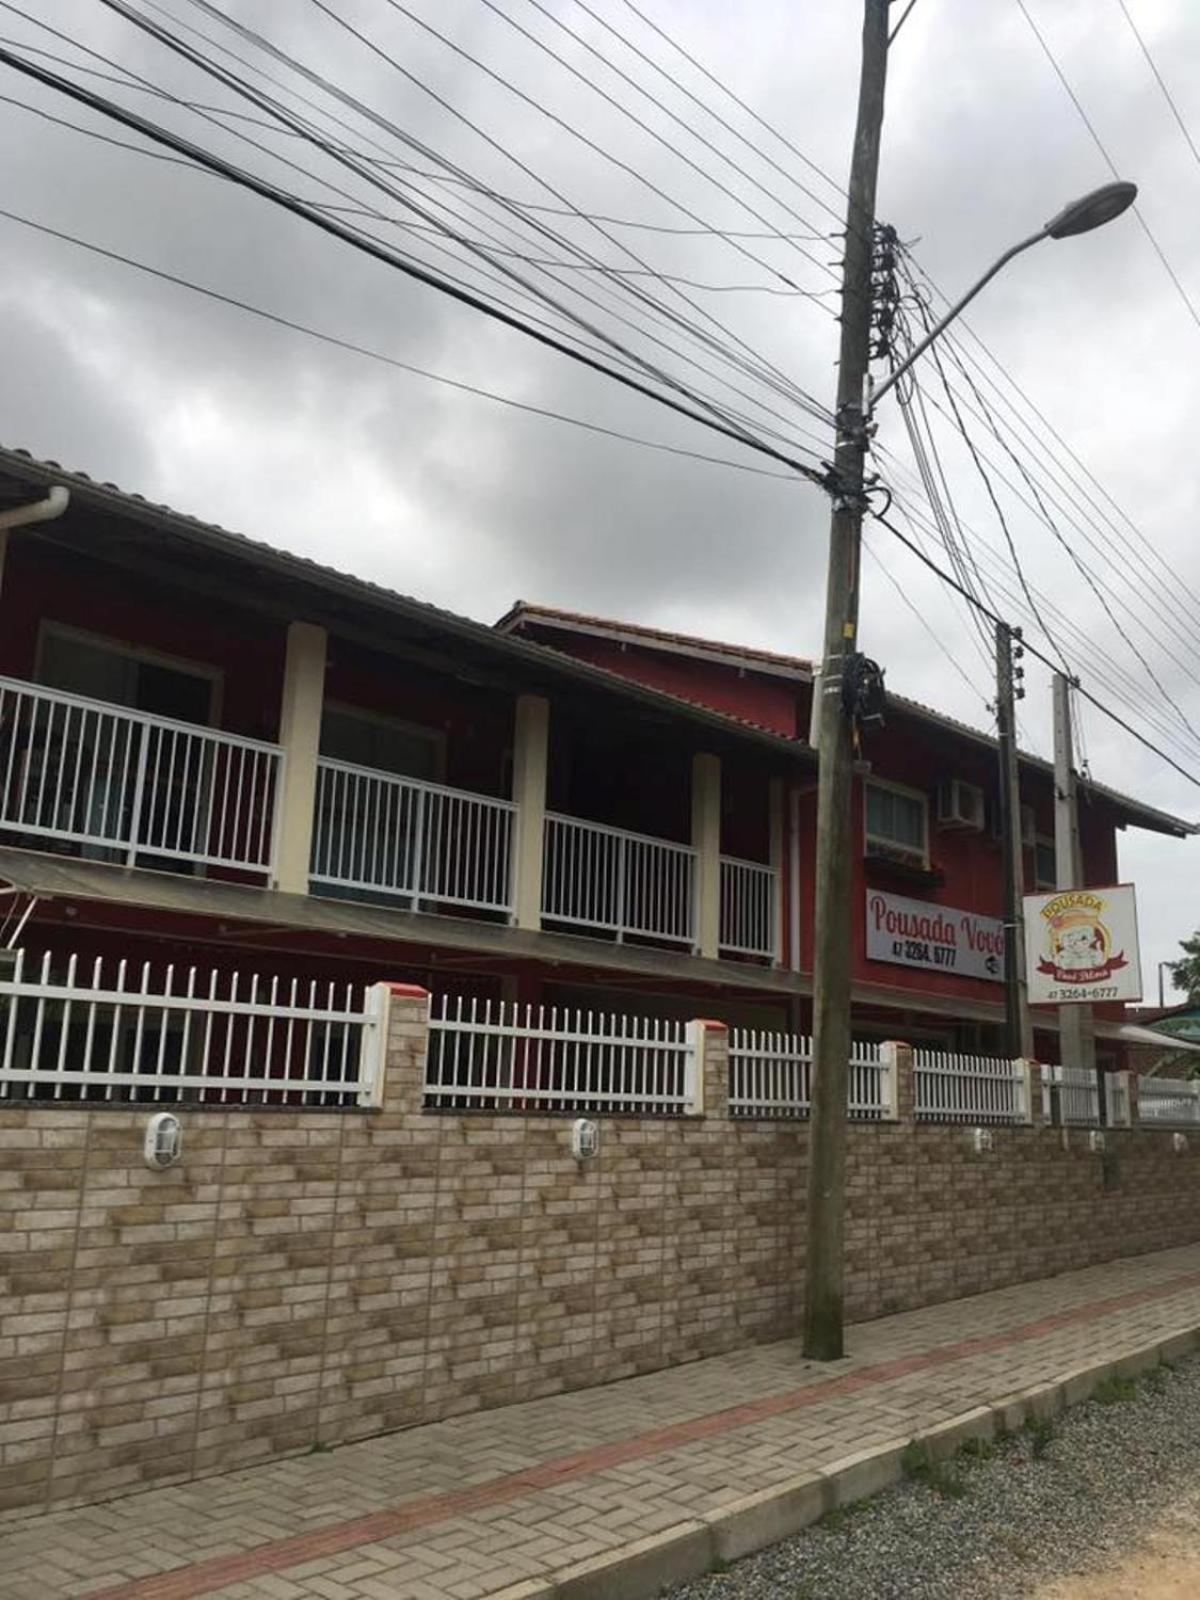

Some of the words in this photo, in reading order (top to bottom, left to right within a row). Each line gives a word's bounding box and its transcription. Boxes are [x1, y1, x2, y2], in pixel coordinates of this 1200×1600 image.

[1041, 893, 1103, 919] POUSADA
[870, 895, 957, 947] Pousada
[960, 916, 1004, 957] Vovó
[892, 941, 902, 957] 47
[1060, 987, 1118, 999] 3264-6777
